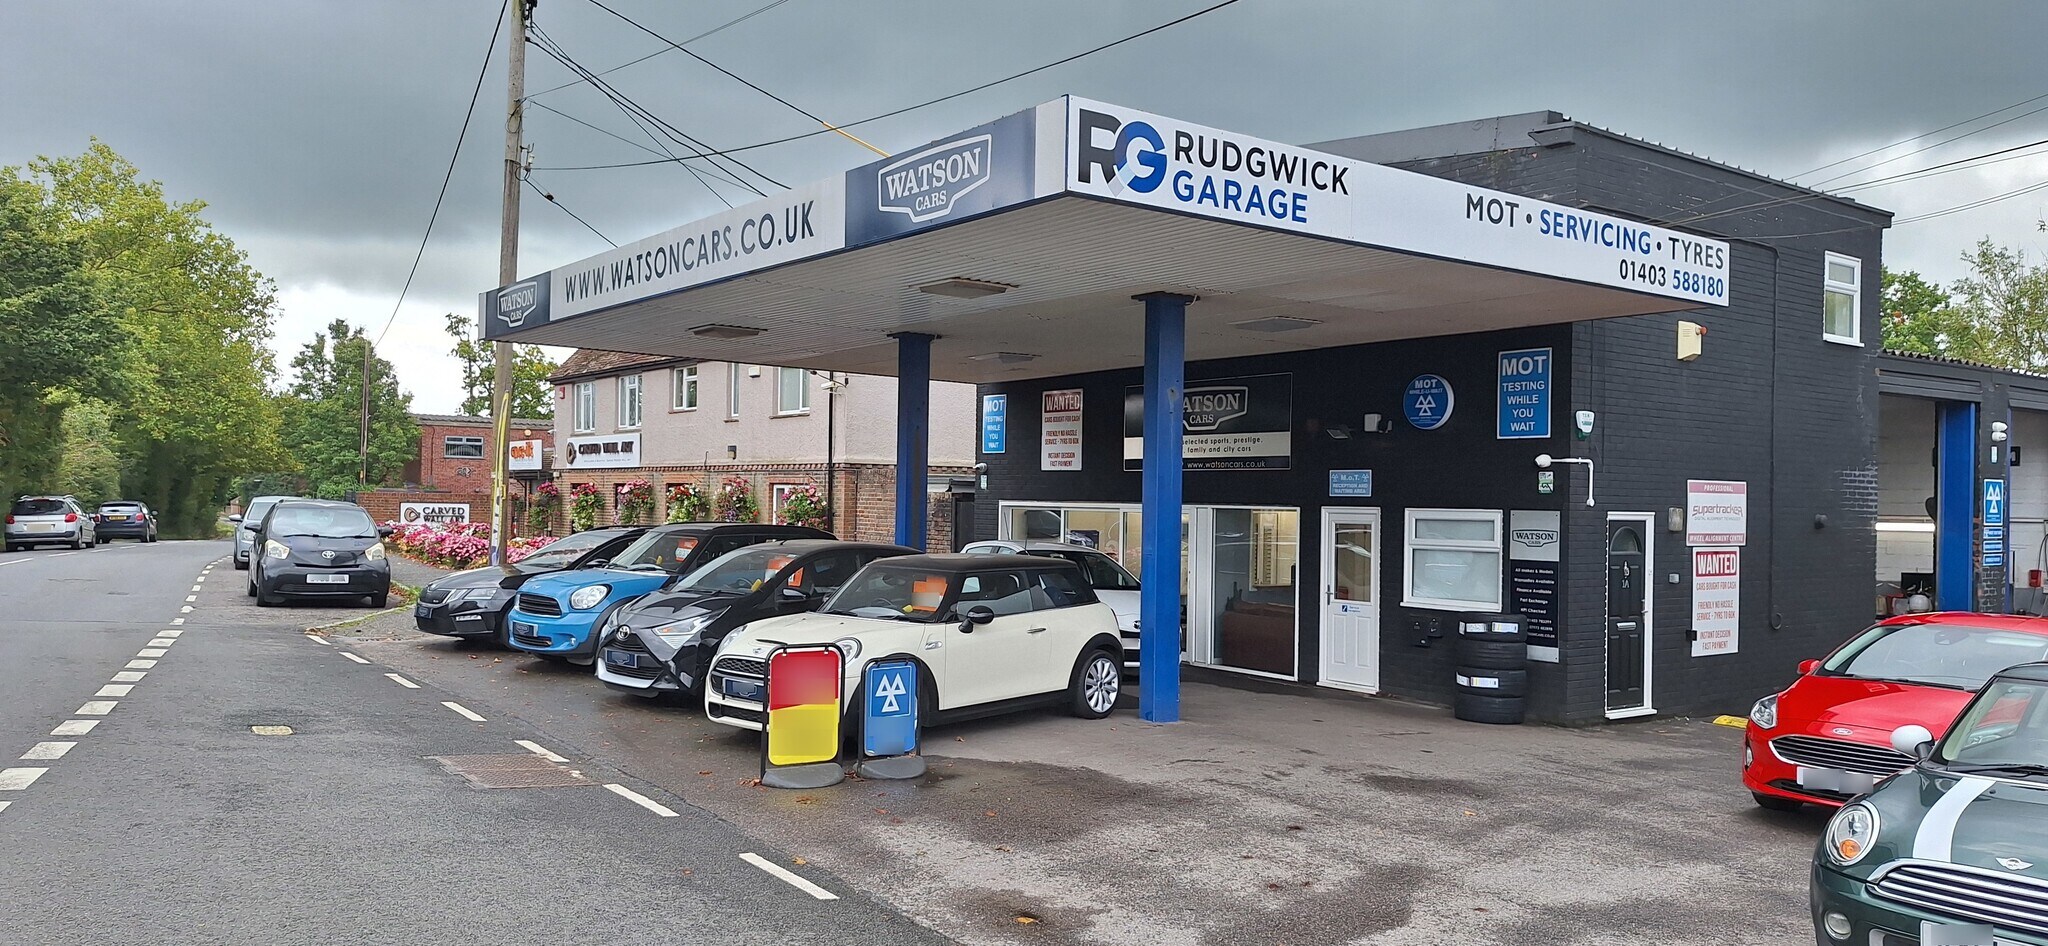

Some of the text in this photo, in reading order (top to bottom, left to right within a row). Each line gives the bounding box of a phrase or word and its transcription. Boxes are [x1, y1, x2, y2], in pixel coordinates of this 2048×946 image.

[1174, 130, 1349, 195] RUDGWICK
[885, 147, 981, 201] WATSON
[915, 190, 947, 212] CARS
[1172, 169, 1308, 223] GARAGE
[1466, 193, 1519, 227] MOT
[1540, 209, 1651, 255] SERVICING
[1668, 236, 1724, 270] TYRES
[565, 200, 815, 303] WWW.WATSONCARS.CO.UK
[1619, 259, 1724, 298] 01403 588180
[500, 288, 534, 313] WATSON
[510, 310, 522, 321] CARS
[1501, 356, 1547, 377] MOT
[1414, 379, 1437, 389] MOT
[1502, 381, 1545, 392] TESTING
[1046, 394, 1080, 412] WANTED
[1183, 393, 1240, 413] ATSON
[1507, 395, 1540, 405] WHILE
[985, 399, 1005, 412] MOT
[1512, 408, 1534, 418] YOU
[985, 415, 1004, 423] TESTING
[1189, 414, 1214, 424] CARS
[987, 424, 1001, 432] WHILE
[1510, 422, 1536, 432] WAIT
[988, 441, 1000, 449] WAIT
[1188, 446, 1206, 454] family
[1223, 446, 1235, 454] city
[1186, 460, 1266, 469] www.watsoncars.co.uk
[1703, 484, 1734, 492] PROFESSIONAL
[422, 506, 465, 515] CARVED
[423, 515, 465, 523] WALL ART
[1515, 532, 1554, 541] WATSON
[1697, 553, 1736, 575] WANTED
[1621, 579, 1630, 589] 1A
[1696, 582, 1705, 591] CARS
[1706, 582, 1719, 590] BOUGHT
[1728, 581, 1736, 589] CASH
[1697, 600, 1733, 609] FRIENDLY NO HASSLE
[1696, 612, 1711, 621] SERVICE
[1723, 611, 1728, 619] TO
[1700, 629, 1731, 639] INSTANT DECISION
[1702, 641, 1728, 650] FAST PAYMENT
